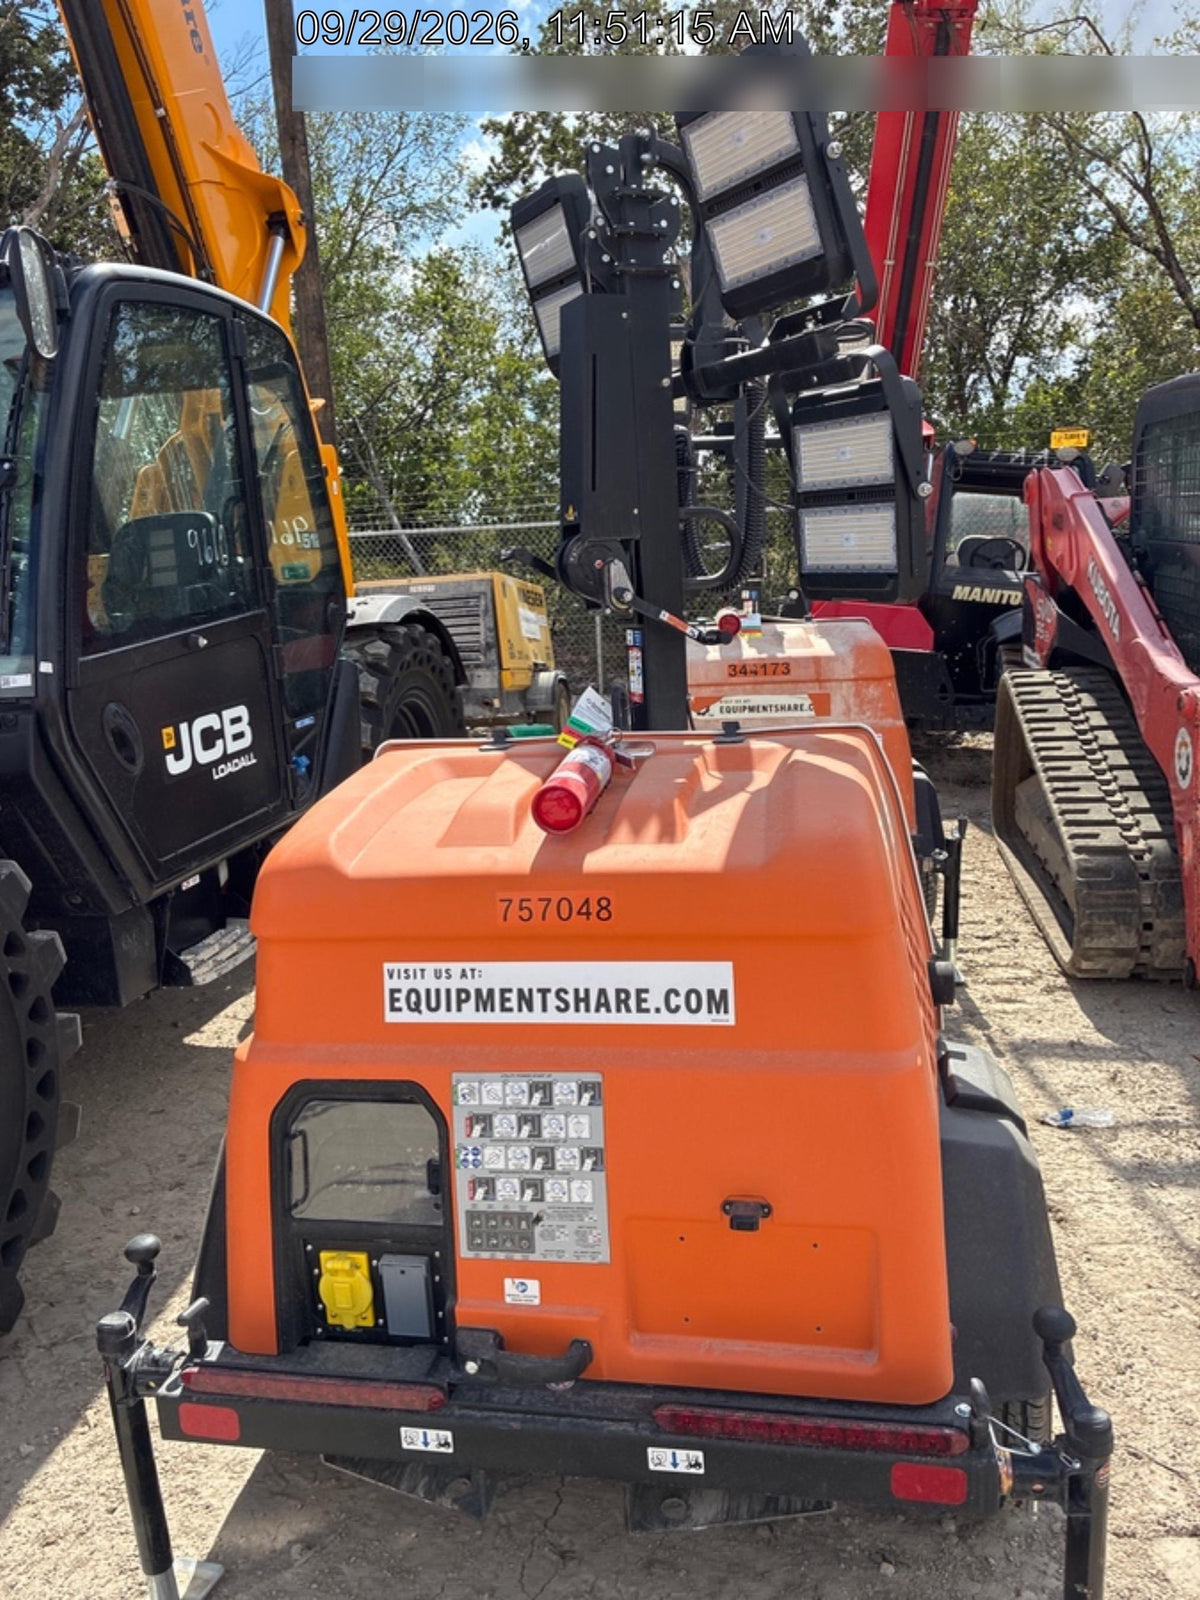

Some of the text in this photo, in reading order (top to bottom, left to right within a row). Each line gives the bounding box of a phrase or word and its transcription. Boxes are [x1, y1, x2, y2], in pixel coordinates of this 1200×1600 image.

[727, 662, 791, 678] 344173
[165, 704, 253, 776] JCB
[212, 753, 258, 780] LOADALL
[498, 896, 612, 922] 757048
[386, 968, 483, 980] VISIT US AT:
[388, 987, 729, 1015] EQUIPMENTSHARE.COM
